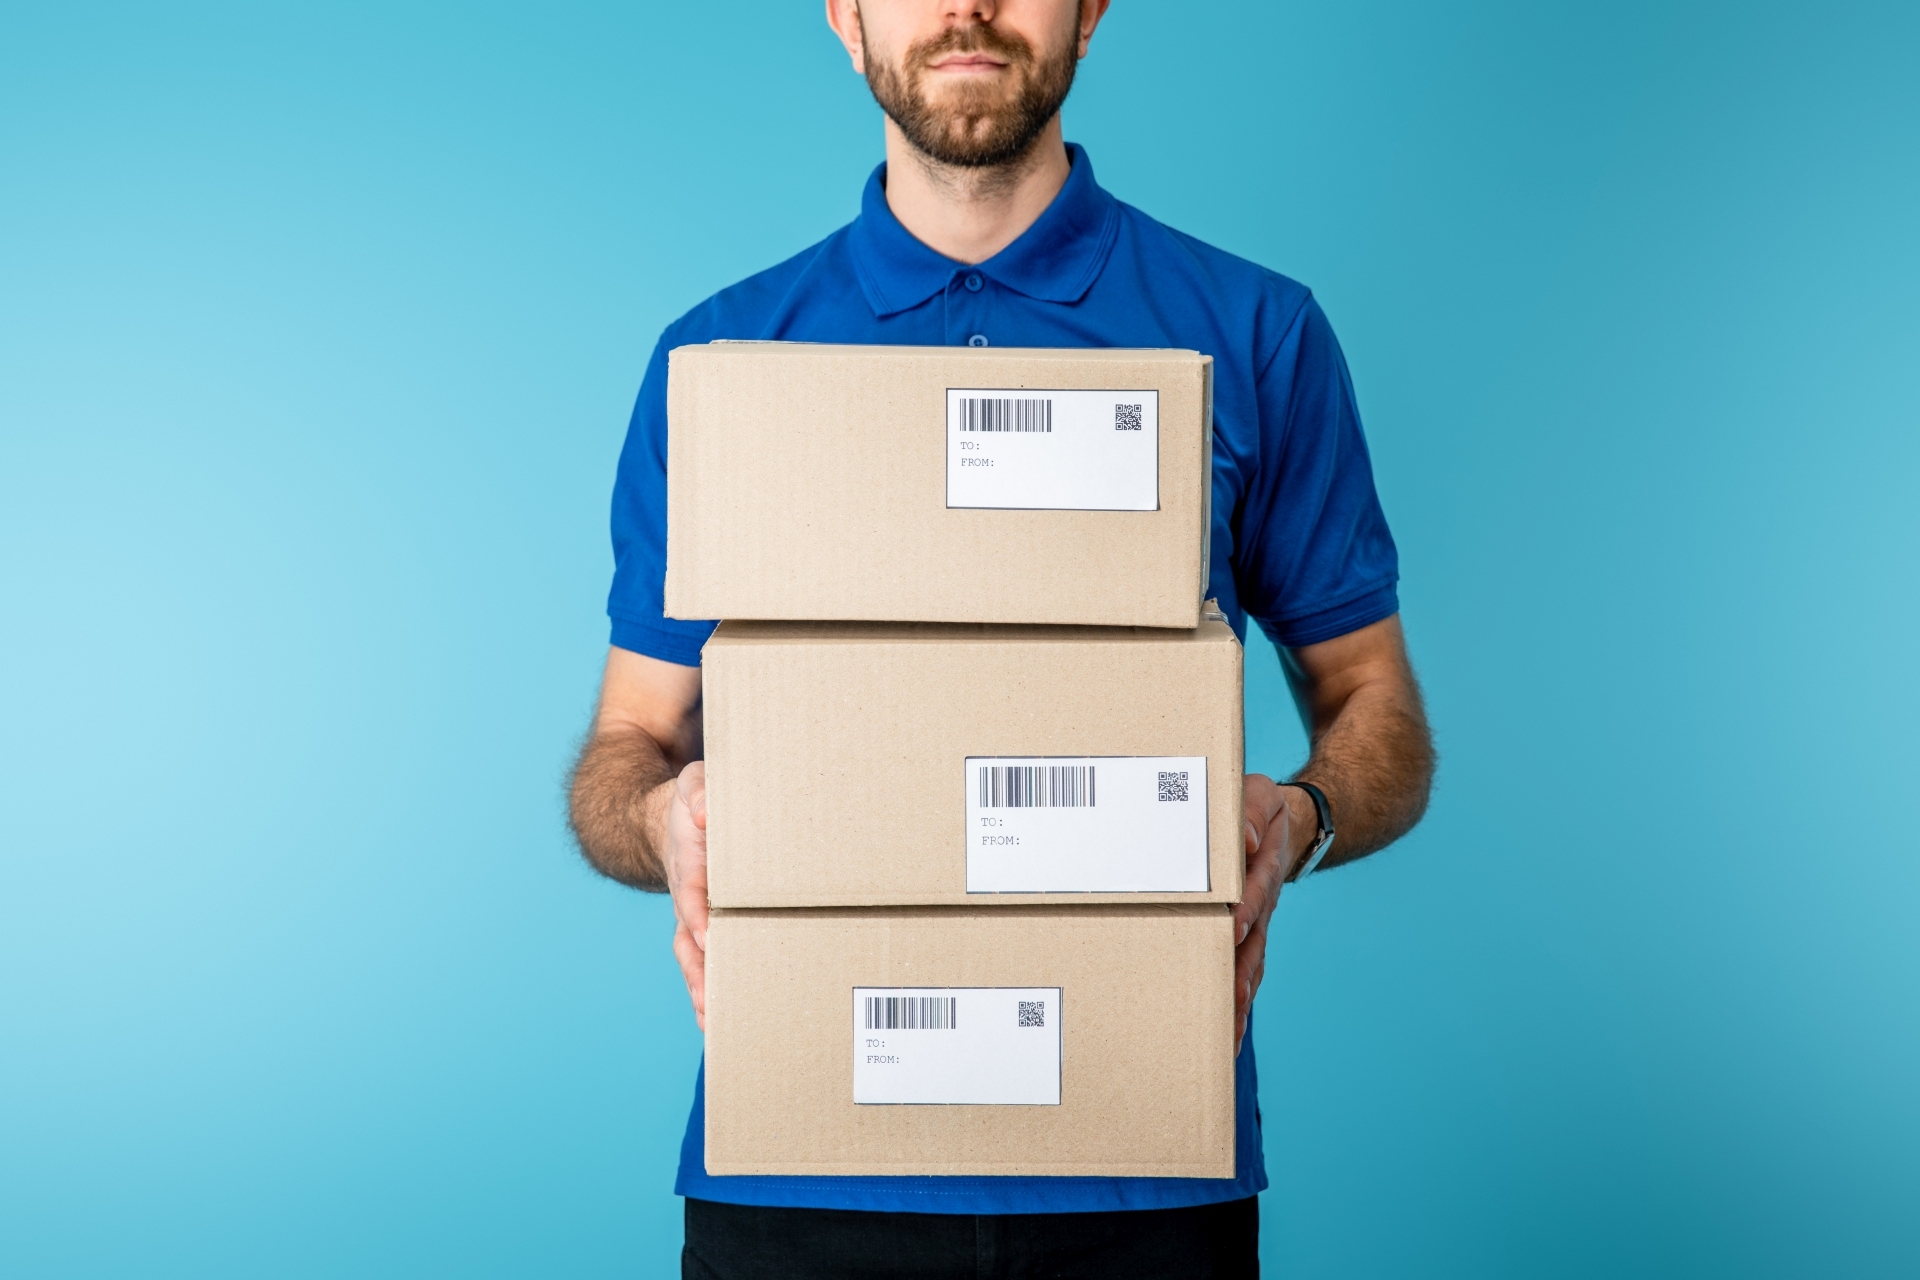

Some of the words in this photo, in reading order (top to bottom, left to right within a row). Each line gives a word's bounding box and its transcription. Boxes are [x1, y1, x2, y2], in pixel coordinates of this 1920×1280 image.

[960, 441, 981, 450] TO:
[960, 458, 995, 467] FROM:
[981, 817, 1004, 827] TO:
[981, 836, 1021, 846] FROM:
[866, 1039, 886, 1048] TO:
[866, 1055, 900, 1064] FROM:
